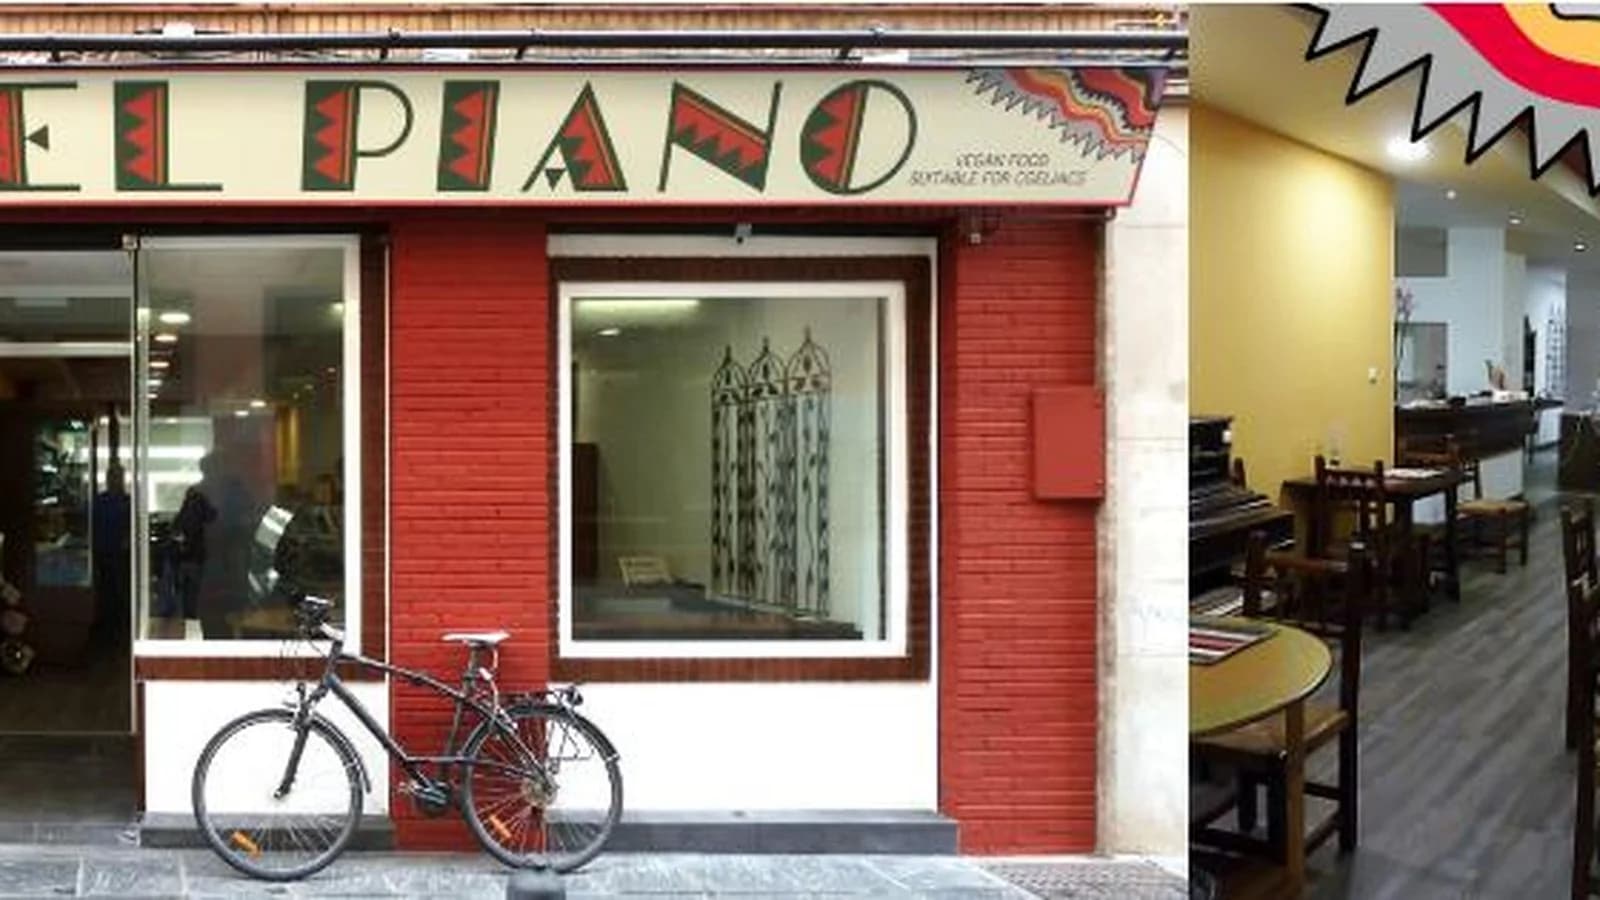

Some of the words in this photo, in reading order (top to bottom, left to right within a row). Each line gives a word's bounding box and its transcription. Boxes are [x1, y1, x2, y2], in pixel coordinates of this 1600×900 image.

[0, 80, 222, 191] EL
[301, 79, 917, 193] PIANO
[956, 152, 1004, 168] VEGAN
[1007, 152, 1050, 167] FOOD
[910, 170, 977, 186] SUITABLE
[982, 170, 1010, 185] FOR
